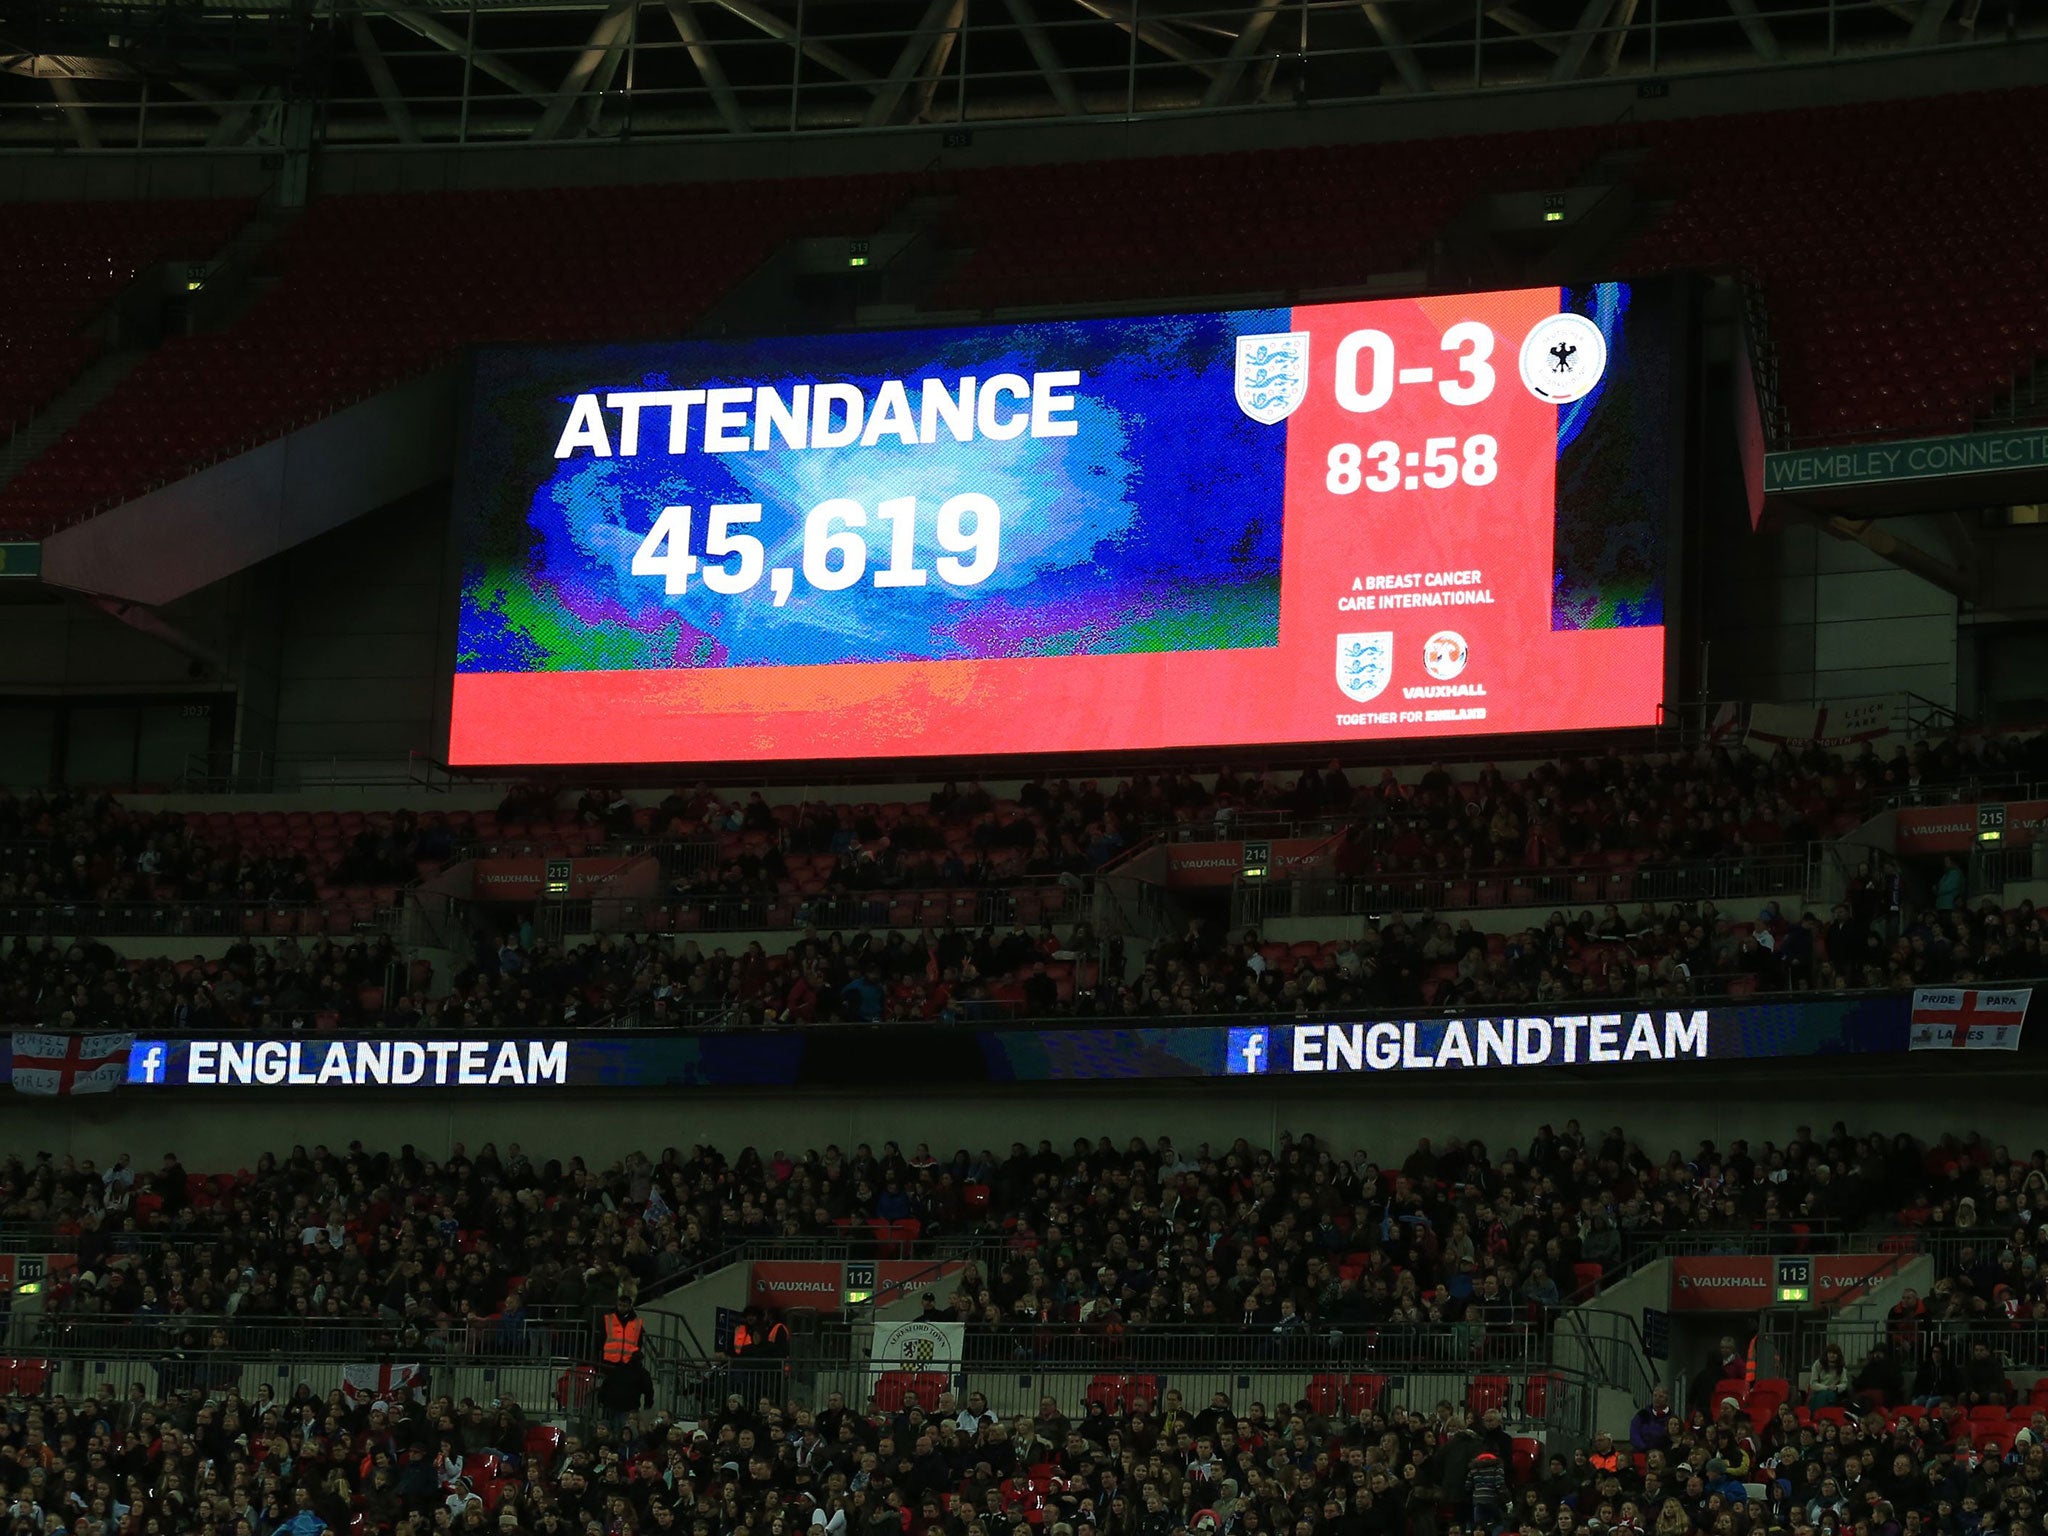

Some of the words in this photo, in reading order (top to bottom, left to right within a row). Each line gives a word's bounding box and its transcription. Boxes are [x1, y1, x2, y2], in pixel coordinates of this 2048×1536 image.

[849, 242, 869, 253] 513
[1335, 321, 1496, 413] 0-3
[554, 370, 1080, 458] ATTENDANCE
[1326, 434, 1498, 495] 83:58
[1772, 450, 1902, 483] WEMBLEY
[632, 492, 1002, 607] 45,619
[1352, 577, 1363, 591] A
[1366, 573, 1422, 590] BREAST
[1425, 570, 1481, 587] CANCER
[1338, 596, 1375, 611] CARE
[1379, 589, 1495, 609] INTERNATIONAL
[1403, 684, 1487, 699] VAUXHALL
[1336, 712, 1397, 726] TOGETHER
[1400, 711, 1423, 723] FOR
[1980, 813, 2003, 825] 215
[1912, 823, 1971, 835] VAUXHALL
[1245, 849, 1268, 861] 214
[1181, 858, 1237, 869] VAUXHALL
[487, 874, 541, 883] VAUXHALL
[548, 867, 569, 878] 213
[1920, 994, 1956, 1005] PRIDE
[1986, 996, 2017, 1006] PARK
[1293, 1010, 1709, 1072] ENGLANDTEAM
[1937, 1029, 1985, 1041] LAES
[188, 1041, 568, 1084] ENGLANDTEAM
[14, 1075, 55, 1088] GIRLS
[21, 1264, 41, 1277] 111
[1780, 1266, 1807, 1281] 113
[848, 1271, 872, 1285] 112
[1692, 1276, 1767, 1287] VAUXHALL
[769, 1281, 834, 1292] VAUXHALL
[928, 1328, 946, 1348] TOWN
